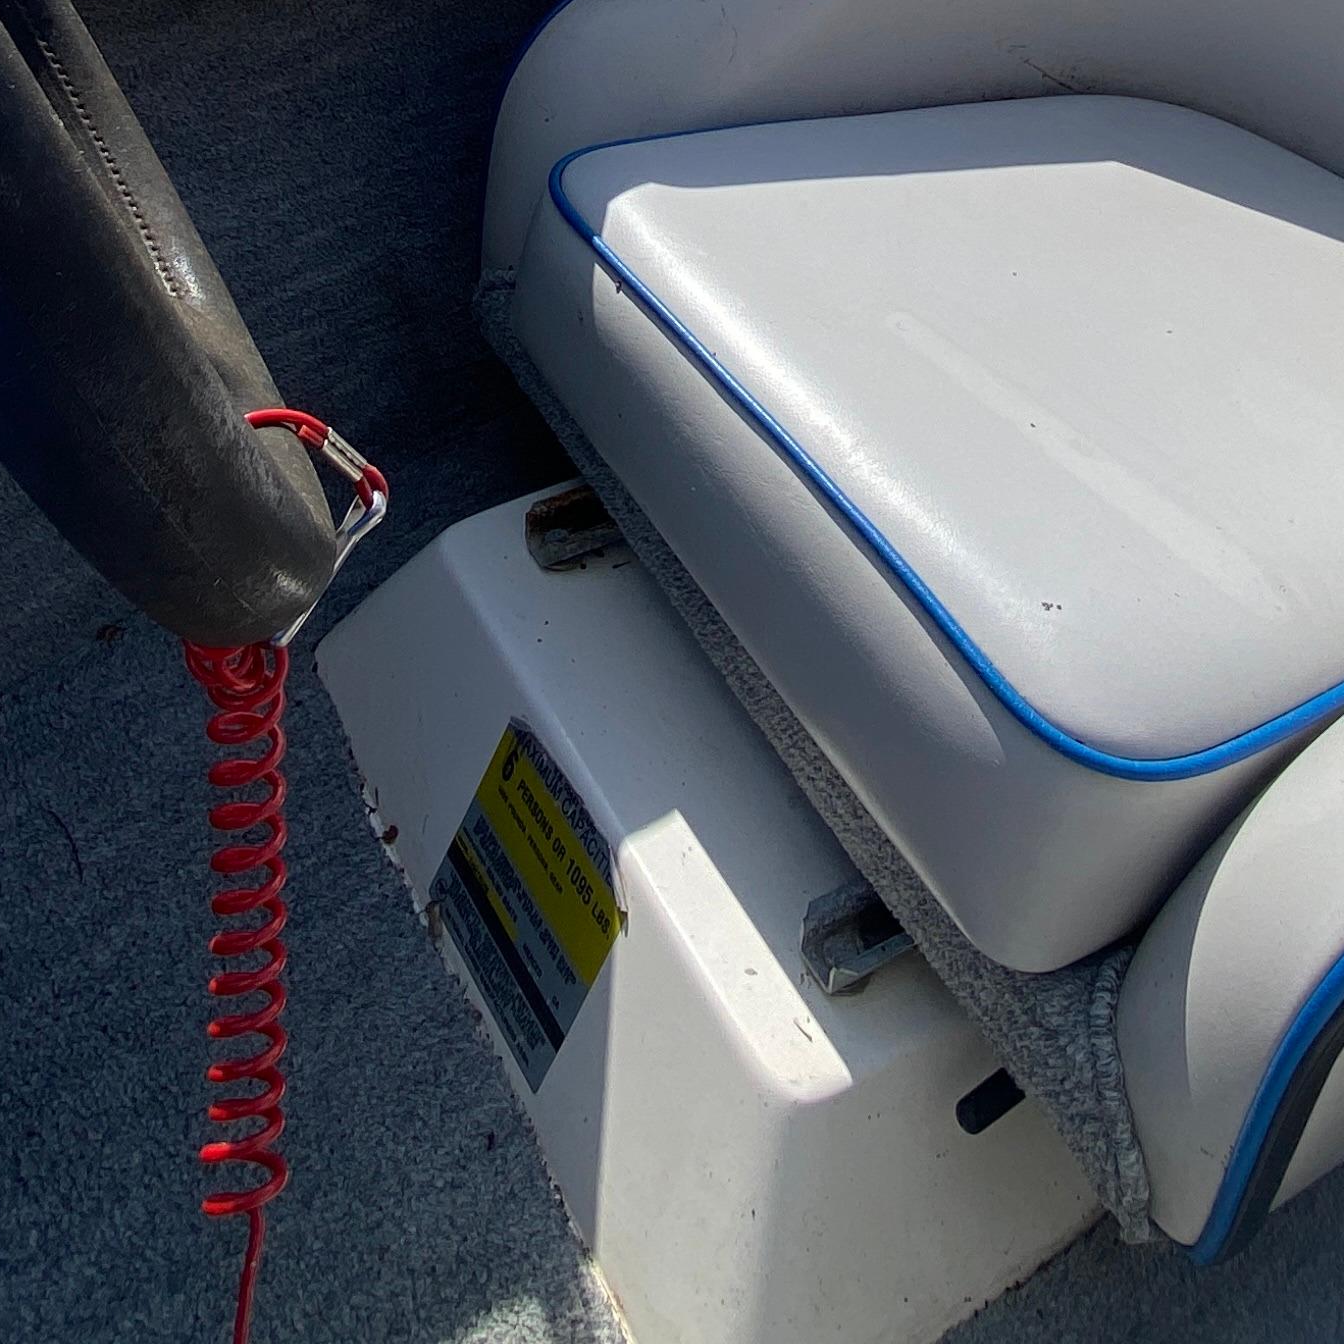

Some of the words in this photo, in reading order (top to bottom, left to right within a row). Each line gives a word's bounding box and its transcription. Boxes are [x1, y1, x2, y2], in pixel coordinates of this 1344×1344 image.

[501, 749, 519, 782] 6
[516, 778, 554, 840] PERSONS
[552, 837, 567, 862] OR
[565, 858, 594, 905] 1095
